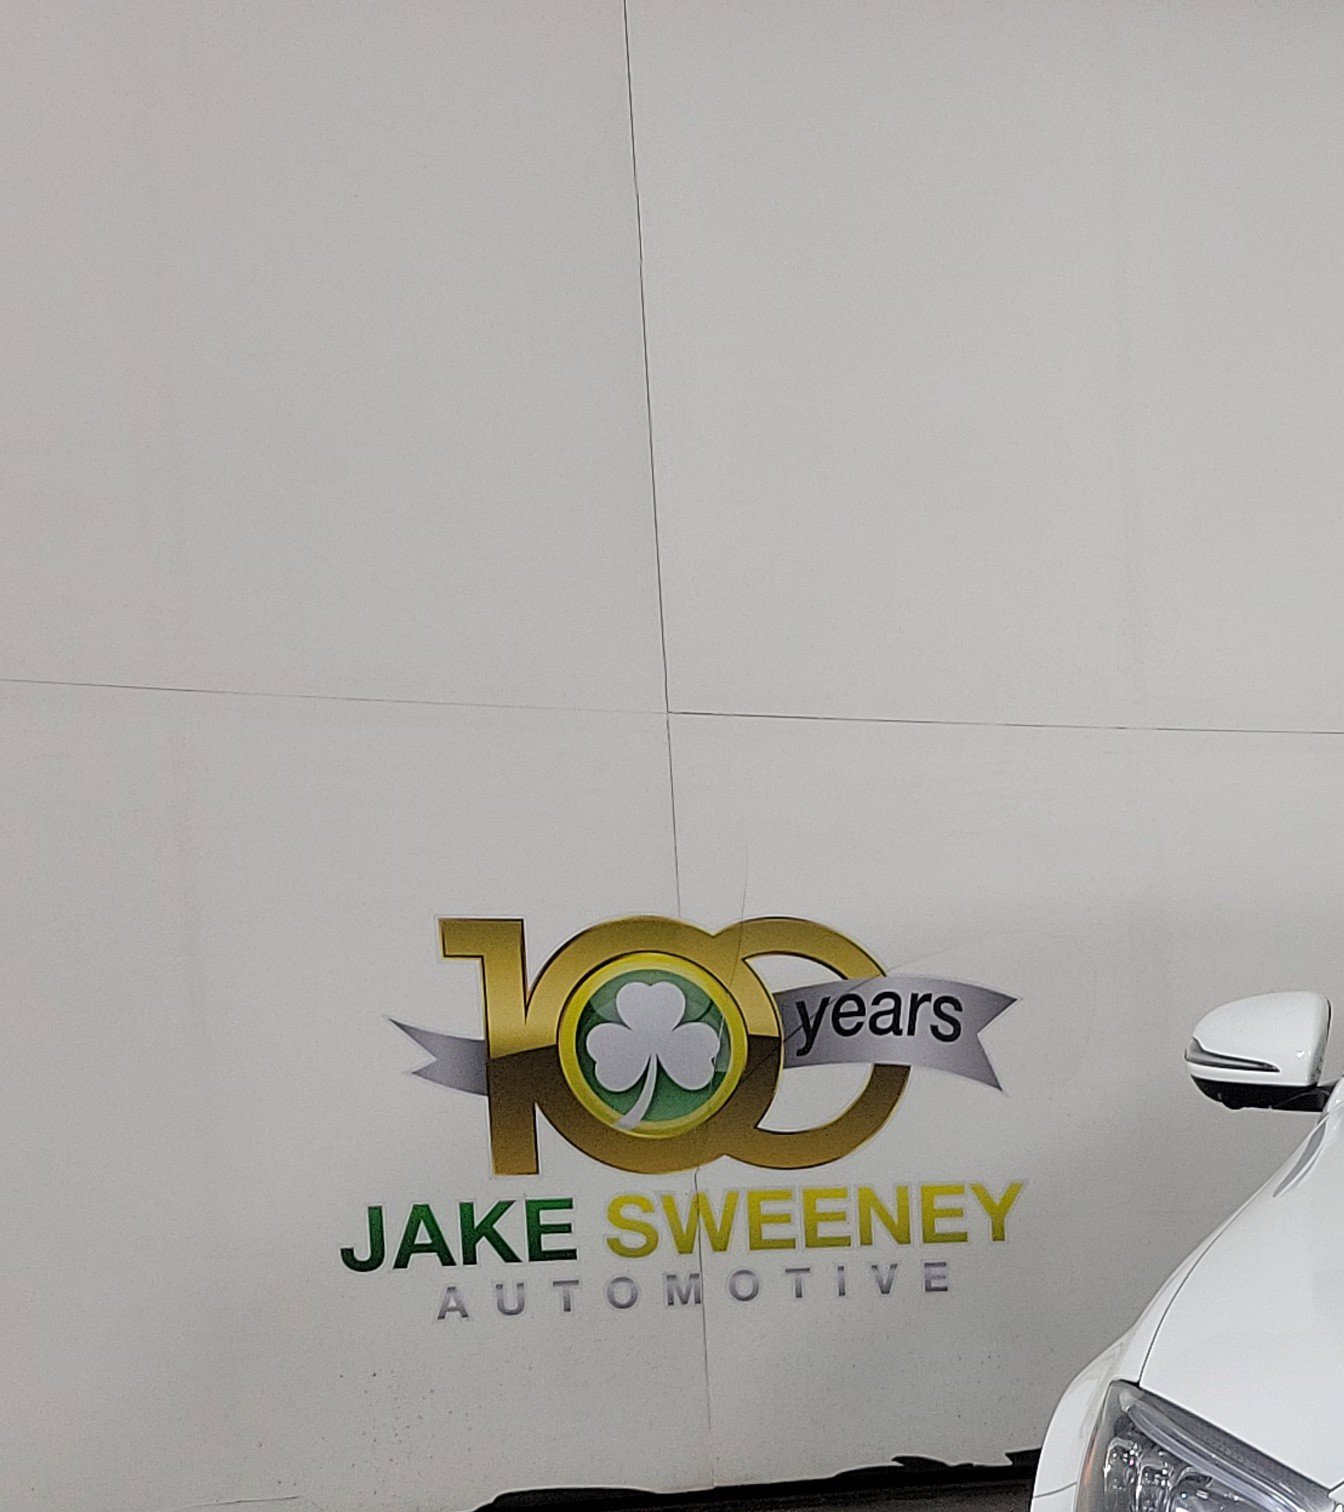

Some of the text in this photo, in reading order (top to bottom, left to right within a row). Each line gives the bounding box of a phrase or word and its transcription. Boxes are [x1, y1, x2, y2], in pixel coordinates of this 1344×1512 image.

[437, 915, 963, 1175] 100 years
[340, 1182, 1024, 1273] JAKE SWEENEY
[436, 1260, 951, 1322] AUTOMOTIVE
